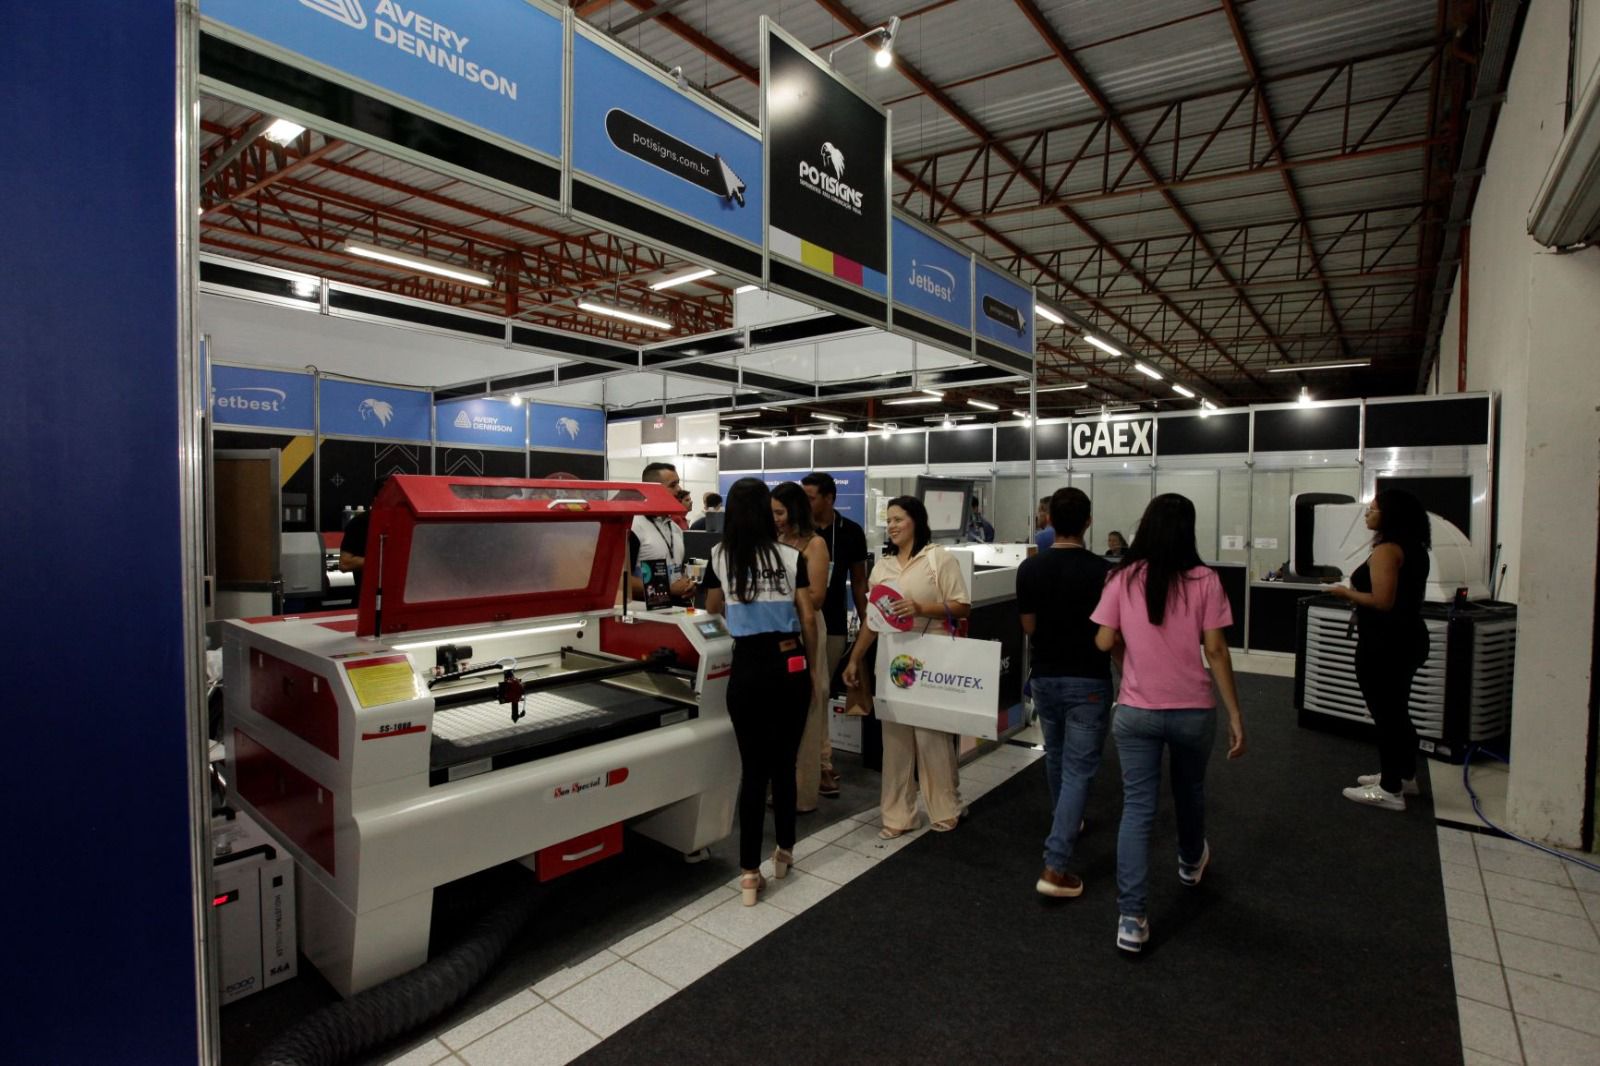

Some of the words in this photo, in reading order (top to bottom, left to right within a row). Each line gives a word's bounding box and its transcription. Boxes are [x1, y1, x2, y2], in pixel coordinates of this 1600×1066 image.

[375, 0, 469, 54] AVERY
[375, 19, 518, 100] DENNISON
[632, 133, 710, 176] potisigns.com.br
[799, 160, 864, 208] POTISIGNS
[908, 259, 952, 303] jetbest
[472, 416, 498, 425] AVERY
[472, 423, 513, 433] DENNISON
[1073, 420, 1152, 456] CAEX
